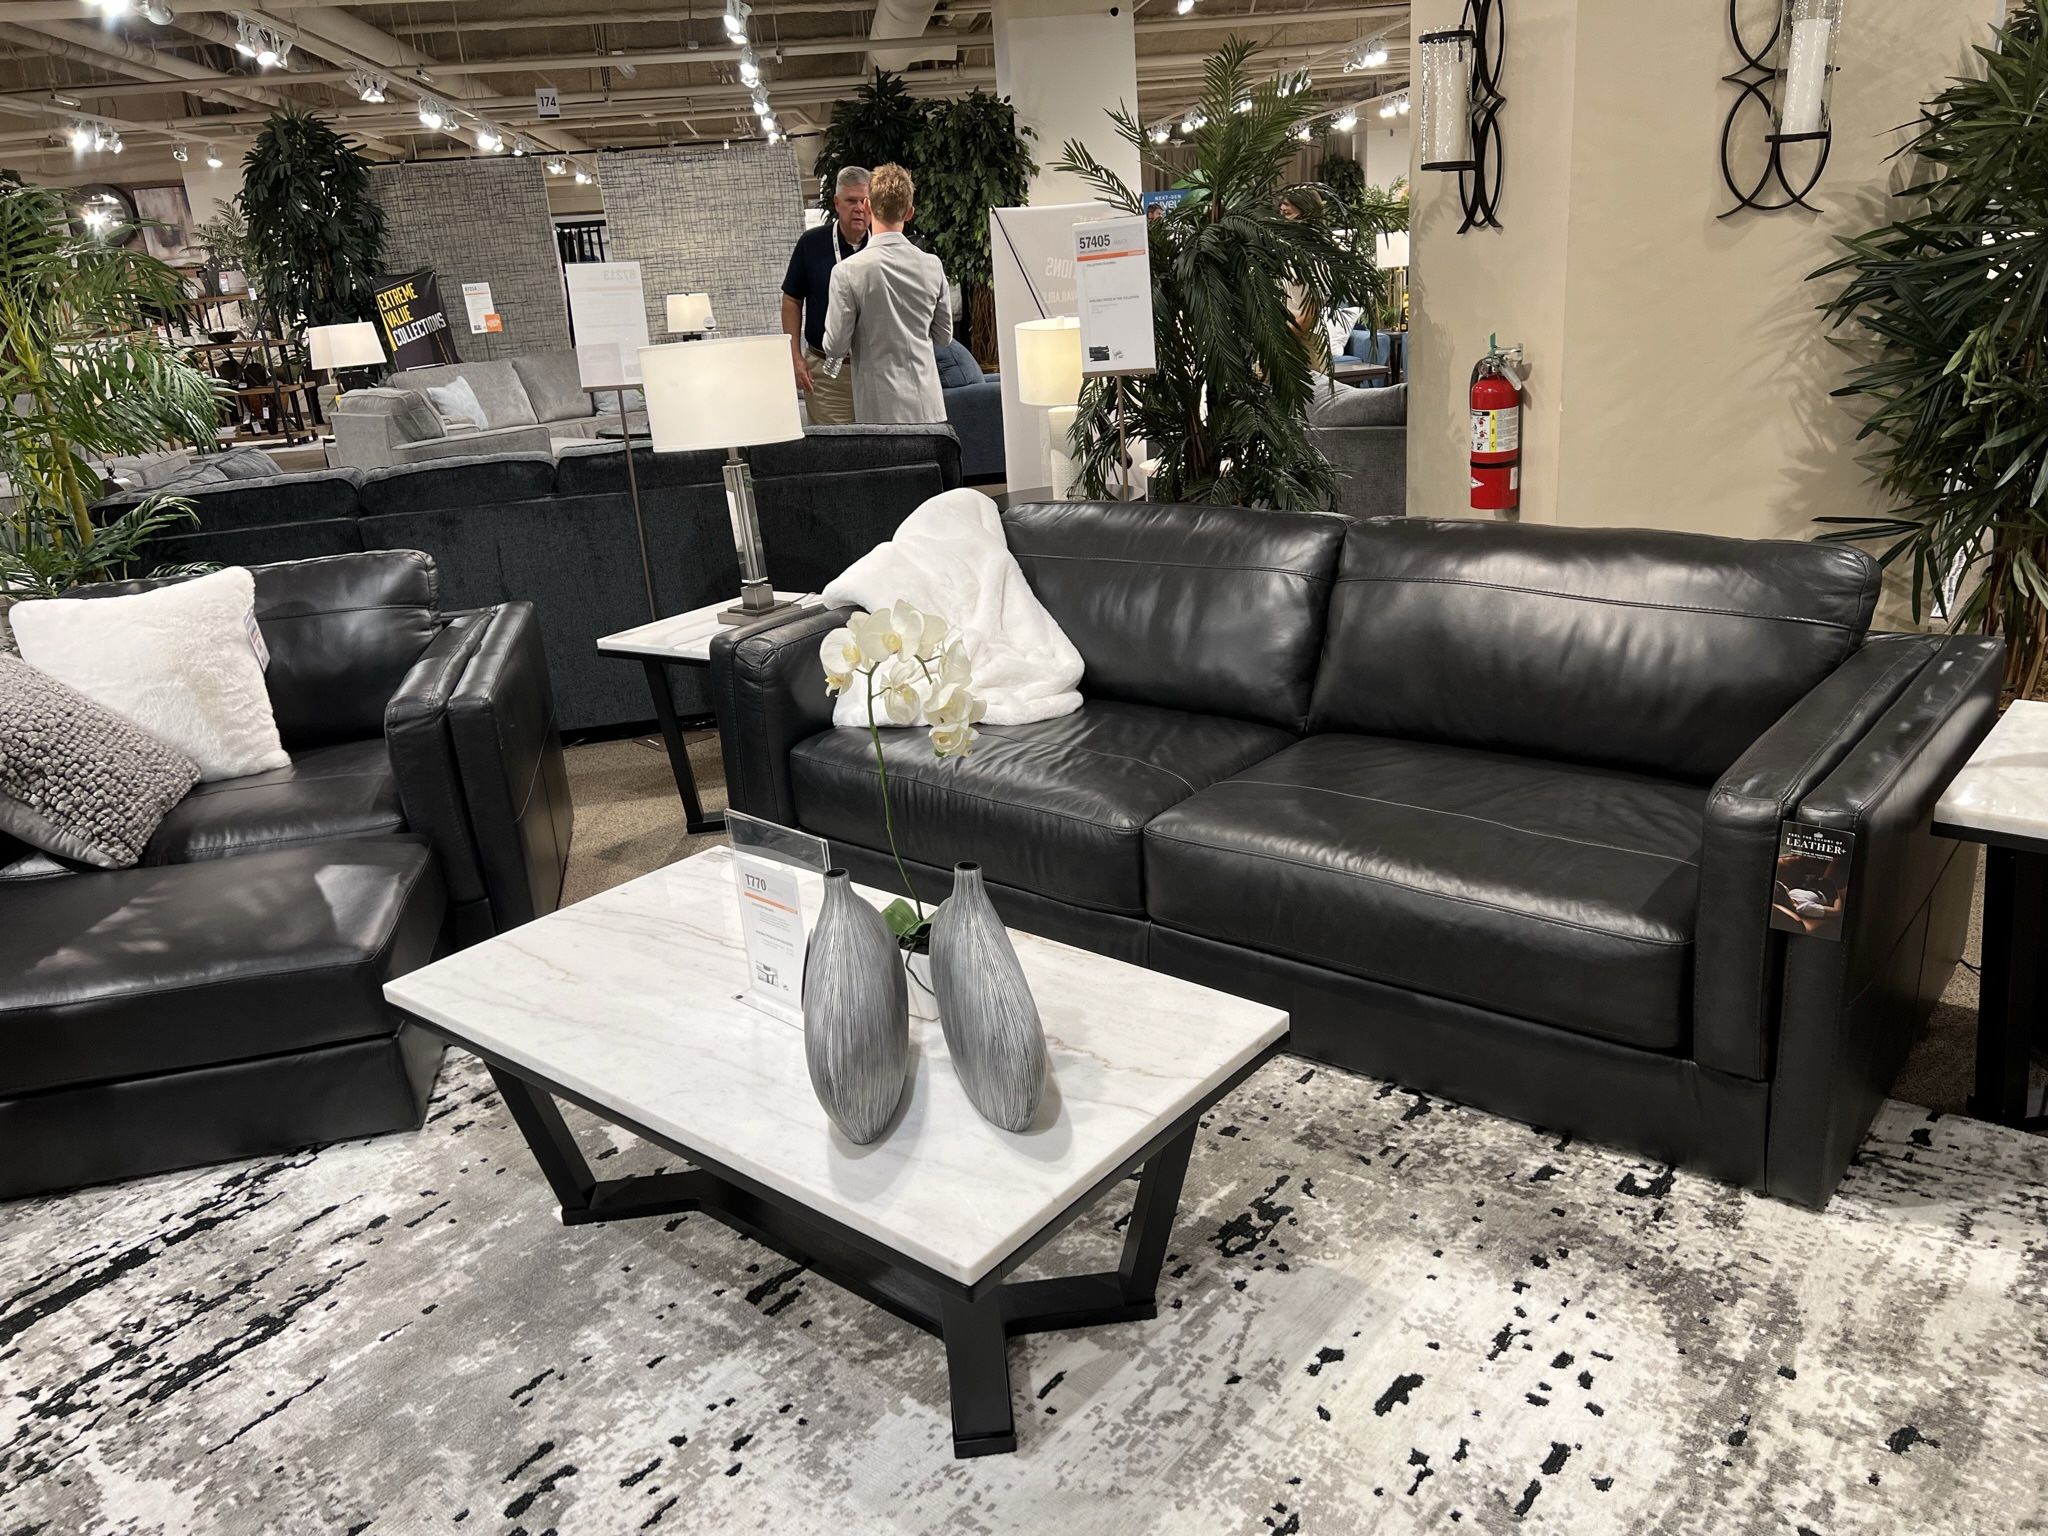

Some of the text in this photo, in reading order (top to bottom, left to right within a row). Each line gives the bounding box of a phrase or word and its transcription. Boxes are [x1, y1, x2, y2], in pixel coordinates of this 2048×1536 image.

[540, 96, 557, 107] 174
[1079, 234, 1111, 250] 57405
[377, 282, 418, 311] EXTREME
[384, 304, 414, 329] VALUE
[392, 311, 447, 347] COLLECTIONS
[744, 873, 767, 891] T770
